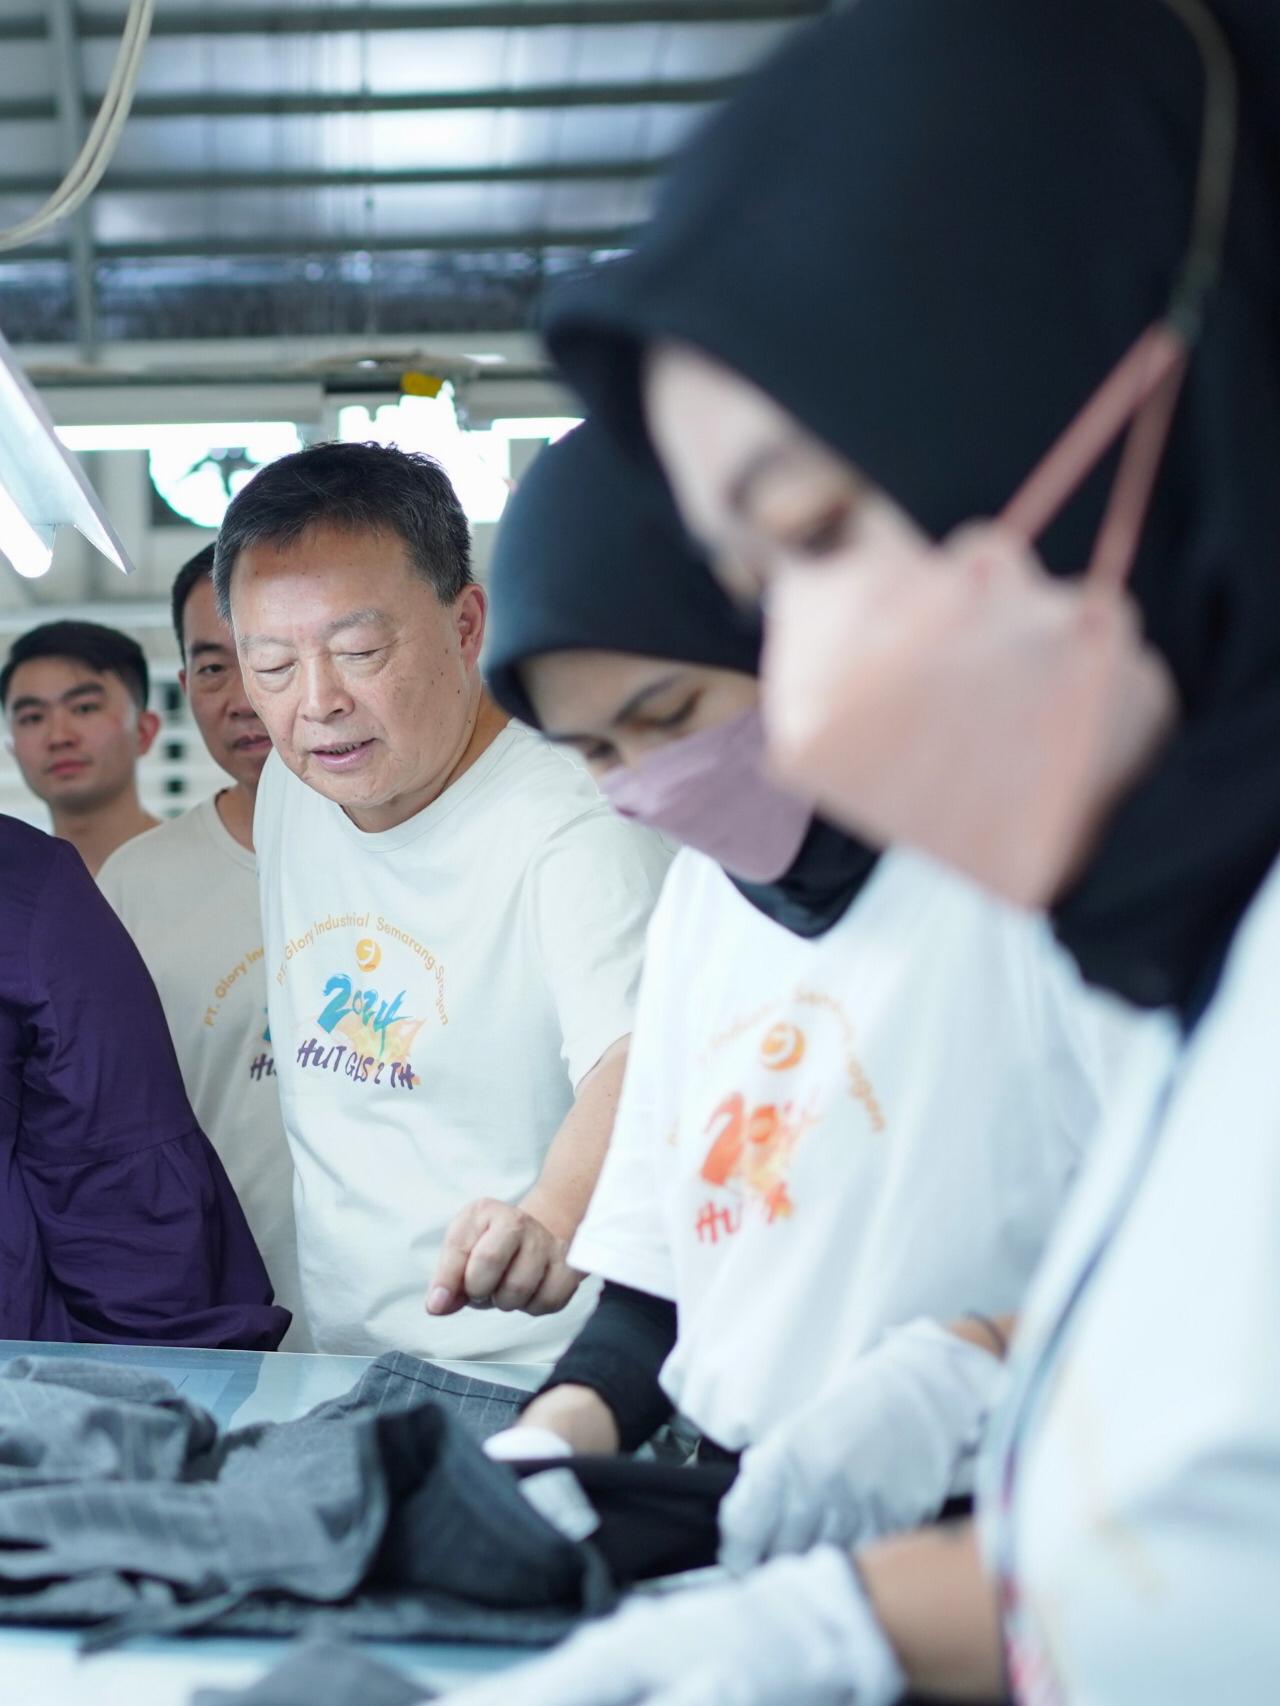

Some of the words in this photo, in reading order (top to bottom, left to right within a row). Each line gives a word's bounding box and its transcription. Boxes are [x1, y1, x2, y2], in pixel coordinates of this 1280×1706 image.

[284, 929, 314, 960] Glory
[313, 912, 370, 936] Industrial
[215, 961, 248, 998] Glory
[317, 973, 414, 1057] 2024
[296, 1037, 349, 1073] HUT
[345, 1050, 376, 1083] GLS
[389, 1061, 416, 1091] TH
